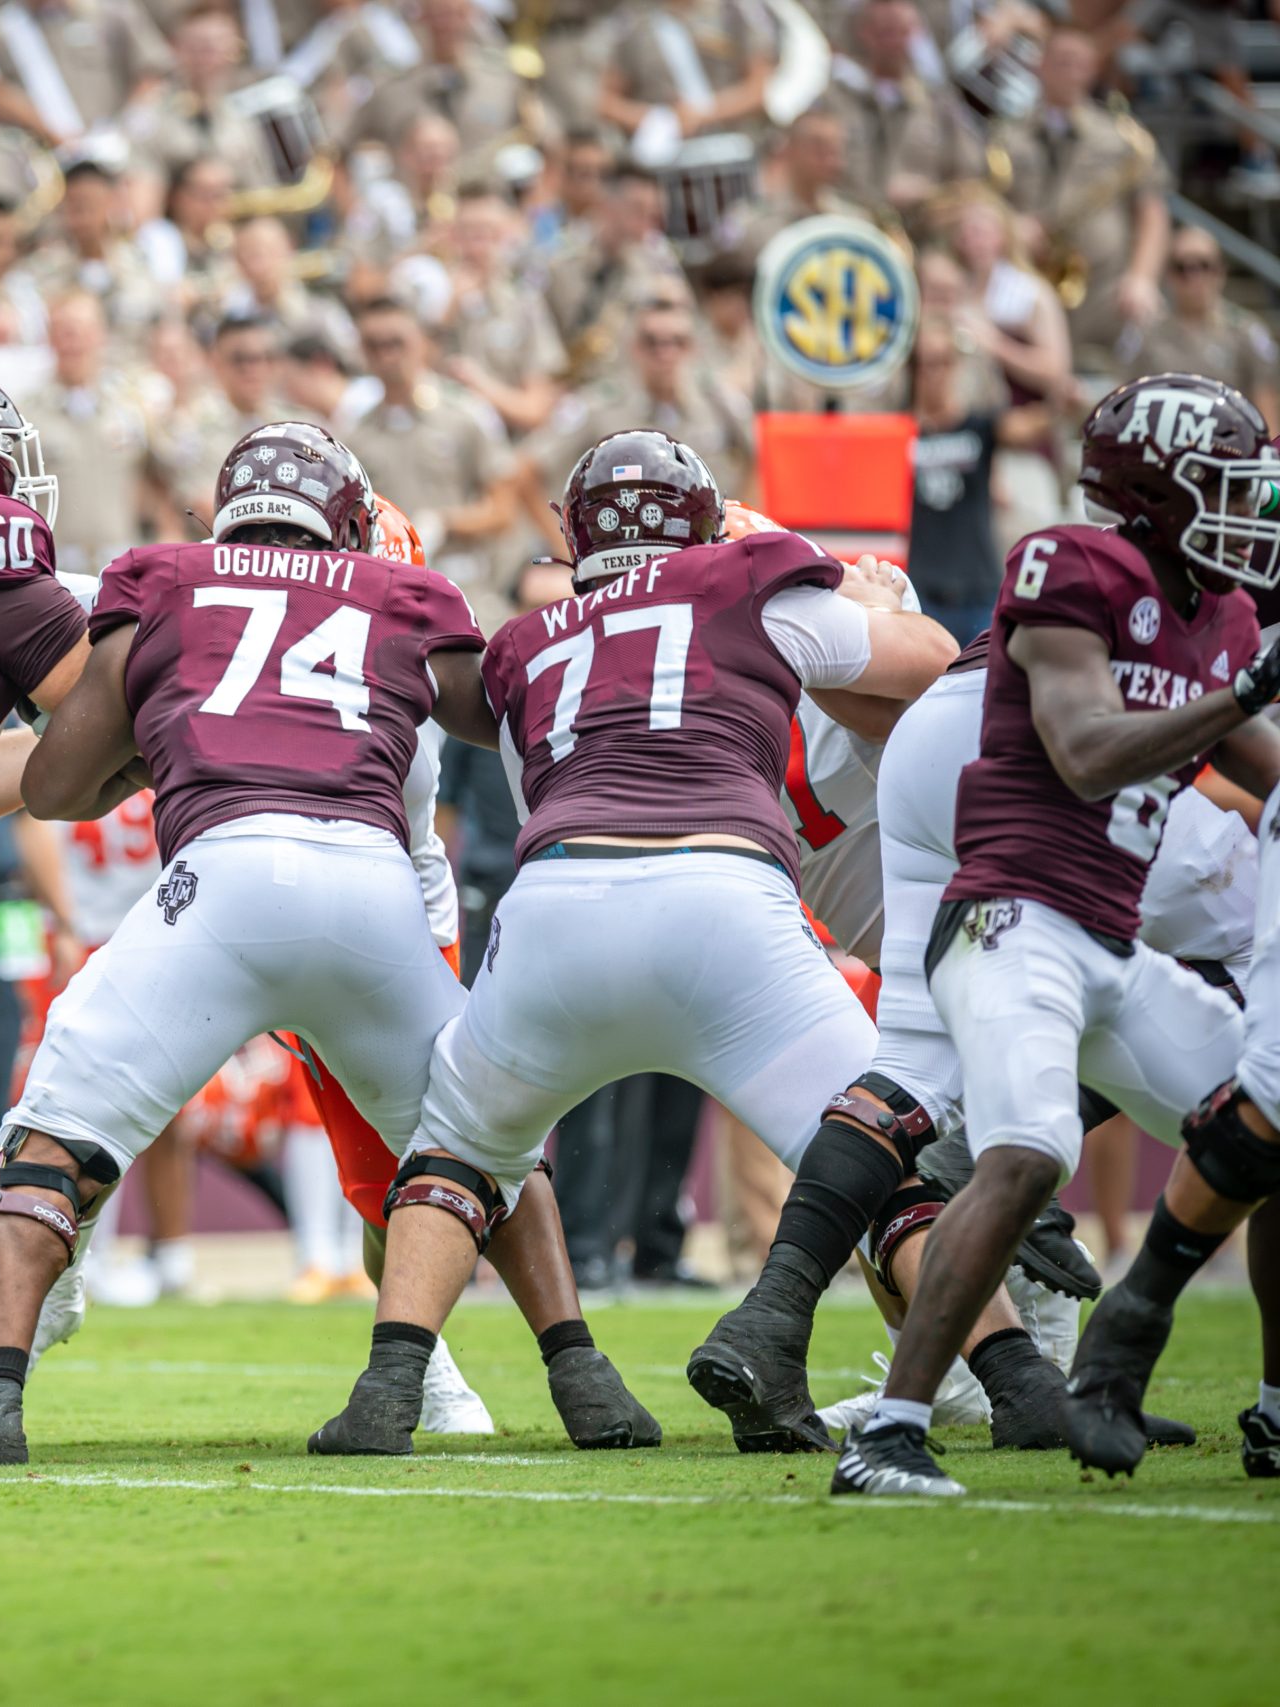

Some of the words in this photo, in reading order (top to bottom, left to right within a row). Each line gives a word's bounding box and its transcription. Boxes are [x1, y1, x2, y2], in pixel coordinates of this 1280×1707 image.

[785, 249, 892, 364] SEC
[252, 480, 270, 492] 74
[230, 502, 264, 519] TEXAS
[267, 502, 292, 516] A&M
[599, 509, 618, 530] SEC
[621, 525, 639, 540] 77
[213, 546, 355, 592] OGUNBIYI
[602, 554, 642, 570] TEXAS
[1014, 538, 1058, 600] 6
[192, 586, 372, 733] 74
[526, 603, 694, 763] 77
